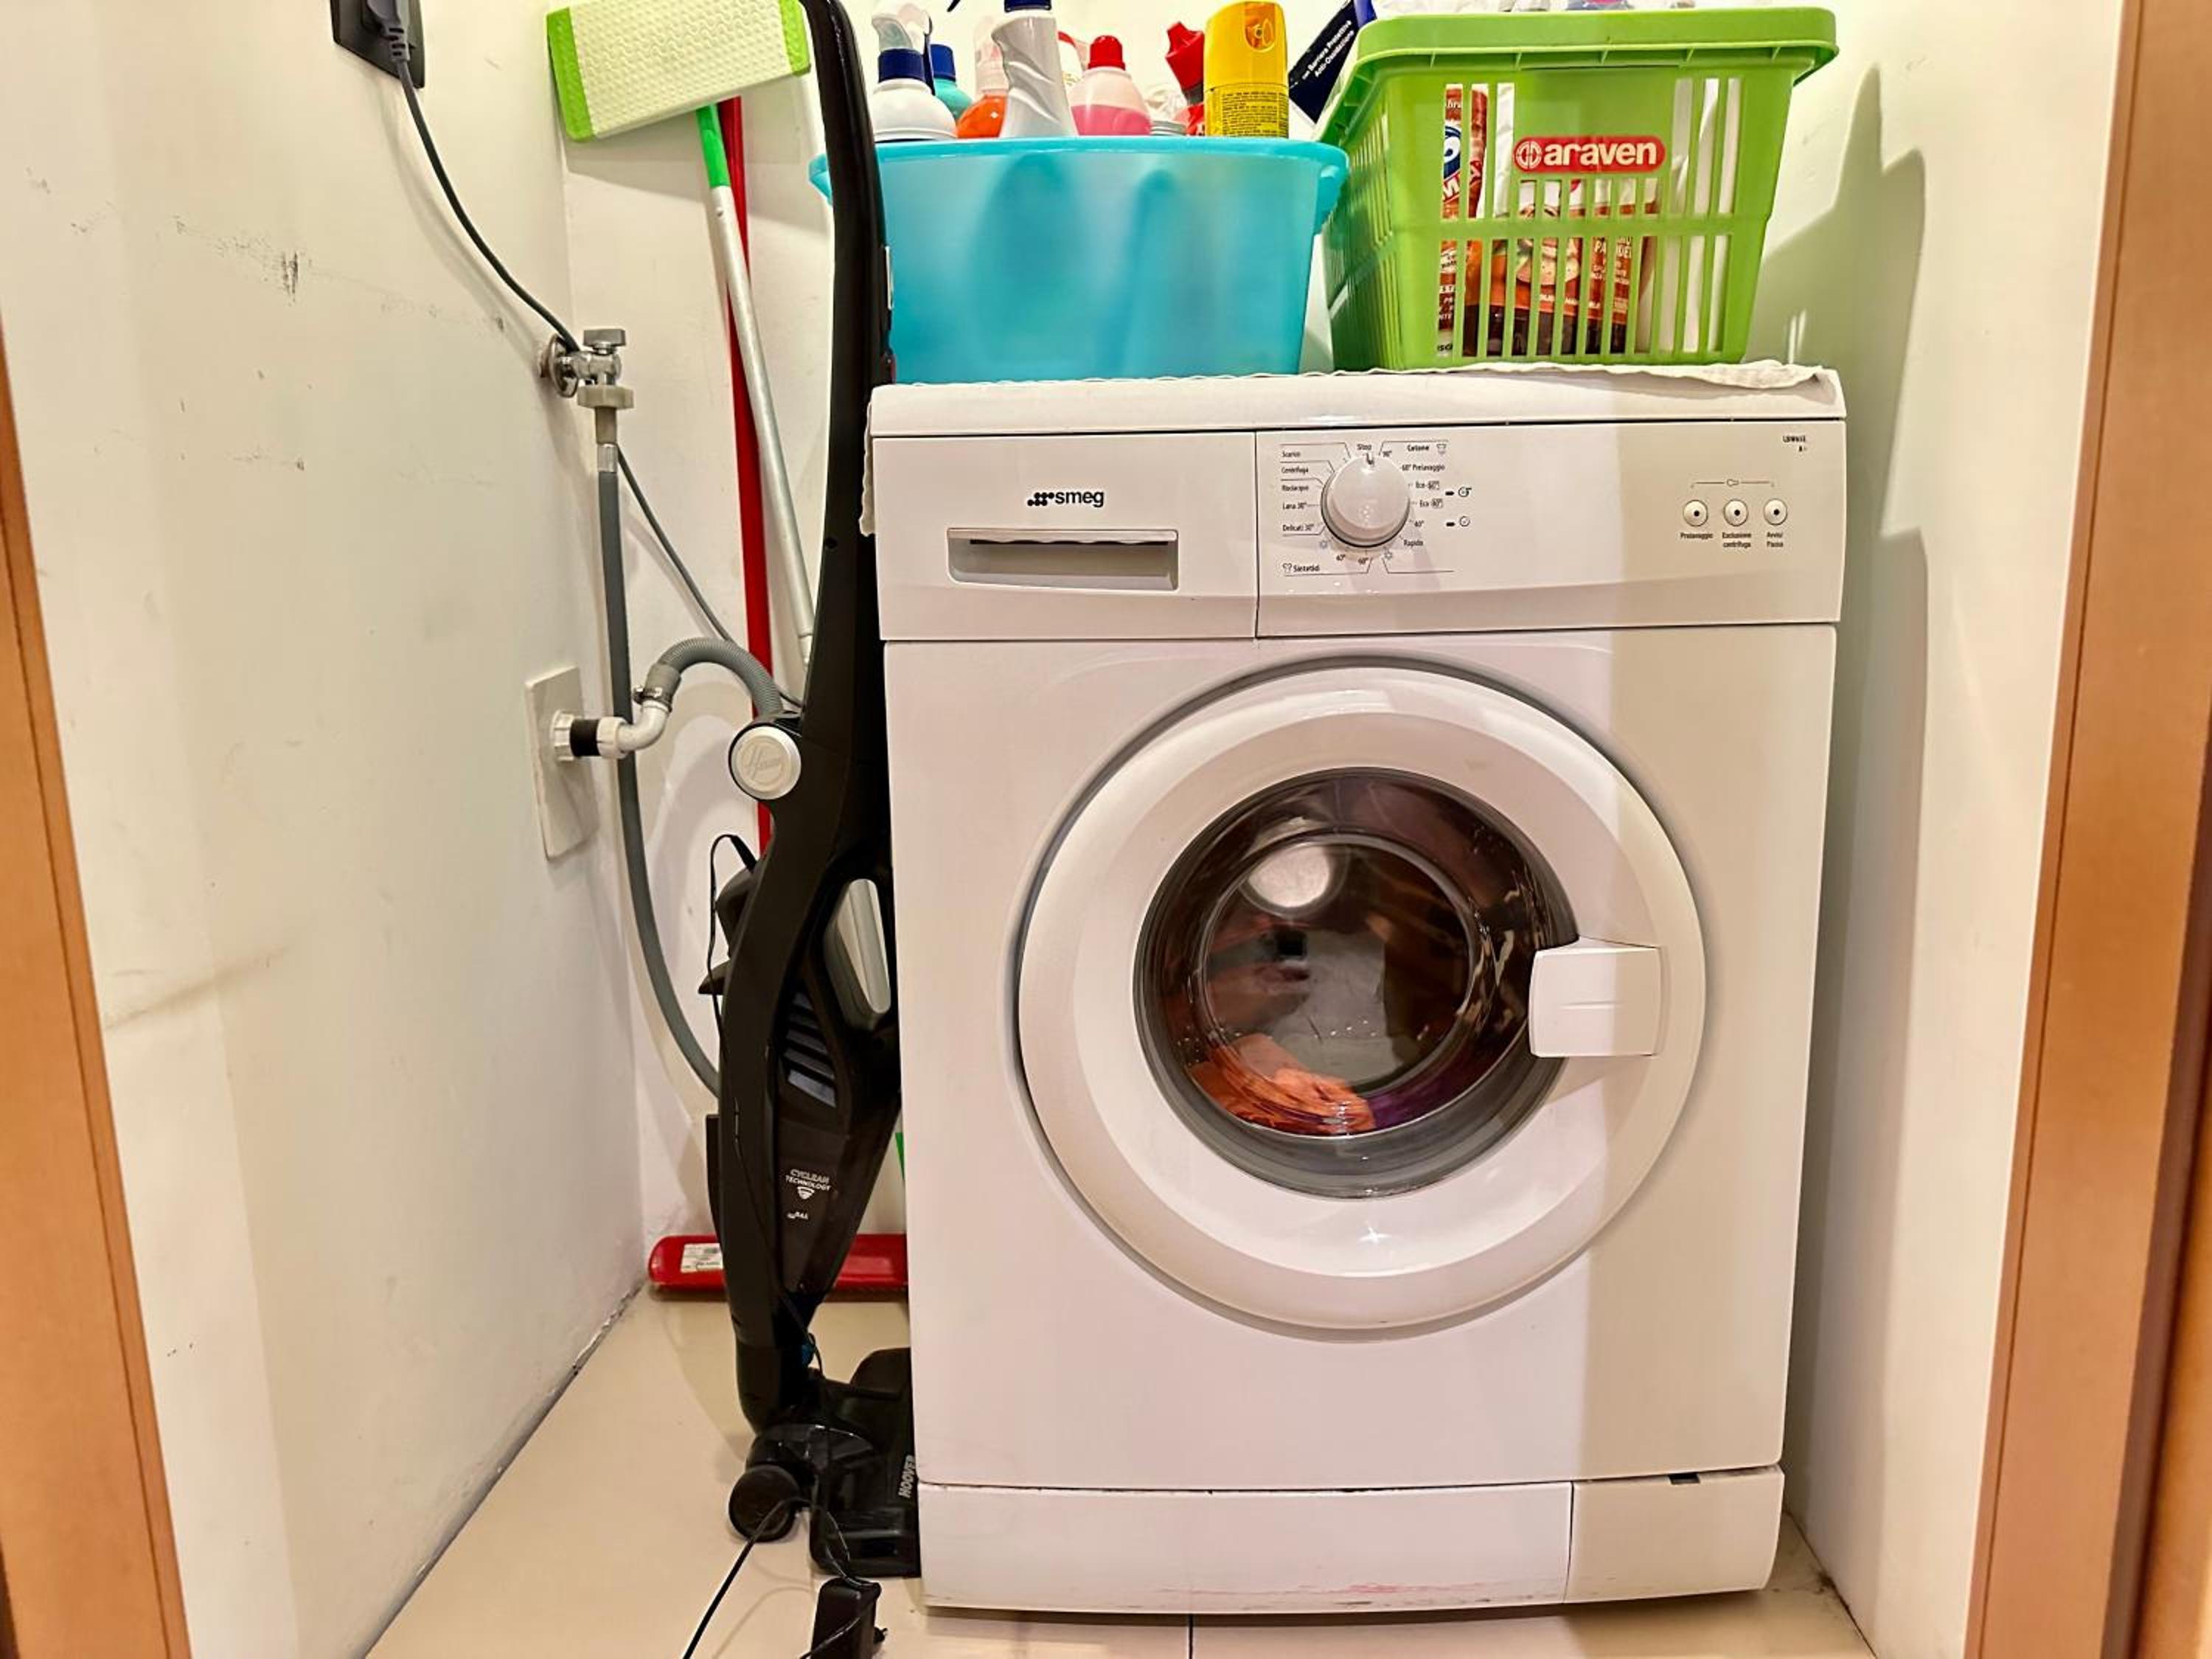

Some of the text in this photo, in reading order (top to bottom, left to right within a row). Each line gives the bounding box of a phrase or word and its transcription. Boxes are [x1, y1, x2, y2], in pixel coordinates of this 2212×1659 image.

[1307, 47, 1329, 72] Barriera
[1315, 30, 1354, 77] Anti-Ossidazione
[1543, 142, 1658, 167] araven
[1412, 464, 1445, 472] Prelavaggio
[1054, 491, 1105, 508] smeg
[1403, 539, 1424, 547] Rapido
[785, 1175, 832, 1191] TECHNOLOGY
[790, 1169, 830, 1184] CYCLEAN
